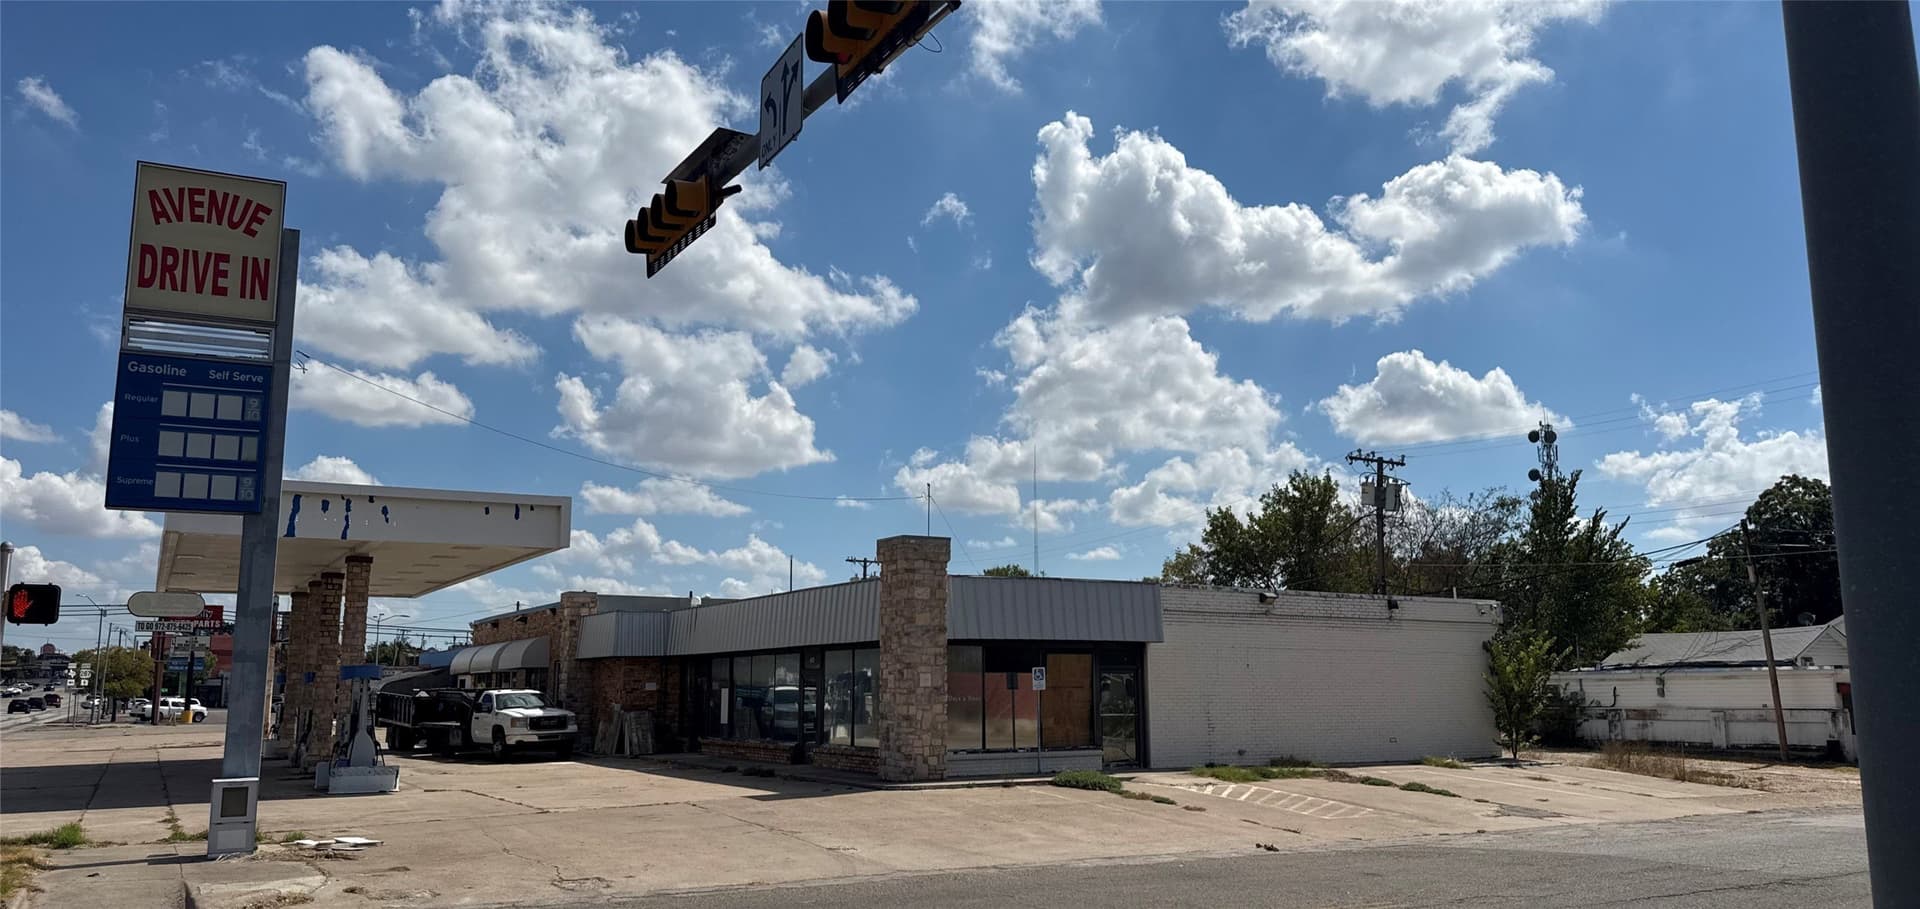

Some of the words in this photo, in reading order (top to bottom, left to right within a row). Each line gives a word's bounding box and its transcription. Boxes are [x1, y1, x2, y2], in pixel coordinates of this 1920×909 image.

[761, 135, 776, 158] ONLY
[148, 187, 272, 239] AVENUE
[137, 243, 230, 297] DRIVE
[239, 256, 271, 301] IN
[127, 360, 187, 377] Gasoline
[208, 369, 229, 381] Self
[232, 371, 264, 383] Serve
[124, 392, 159, 403] Regular
[120, 434, 139, 443] Plus
[117, 476, 154, 486] Supreme
[137, 622, 144, 630] TO
[146, 622, 153, 630] GO
[193, 620, 221, 628] PARTS
